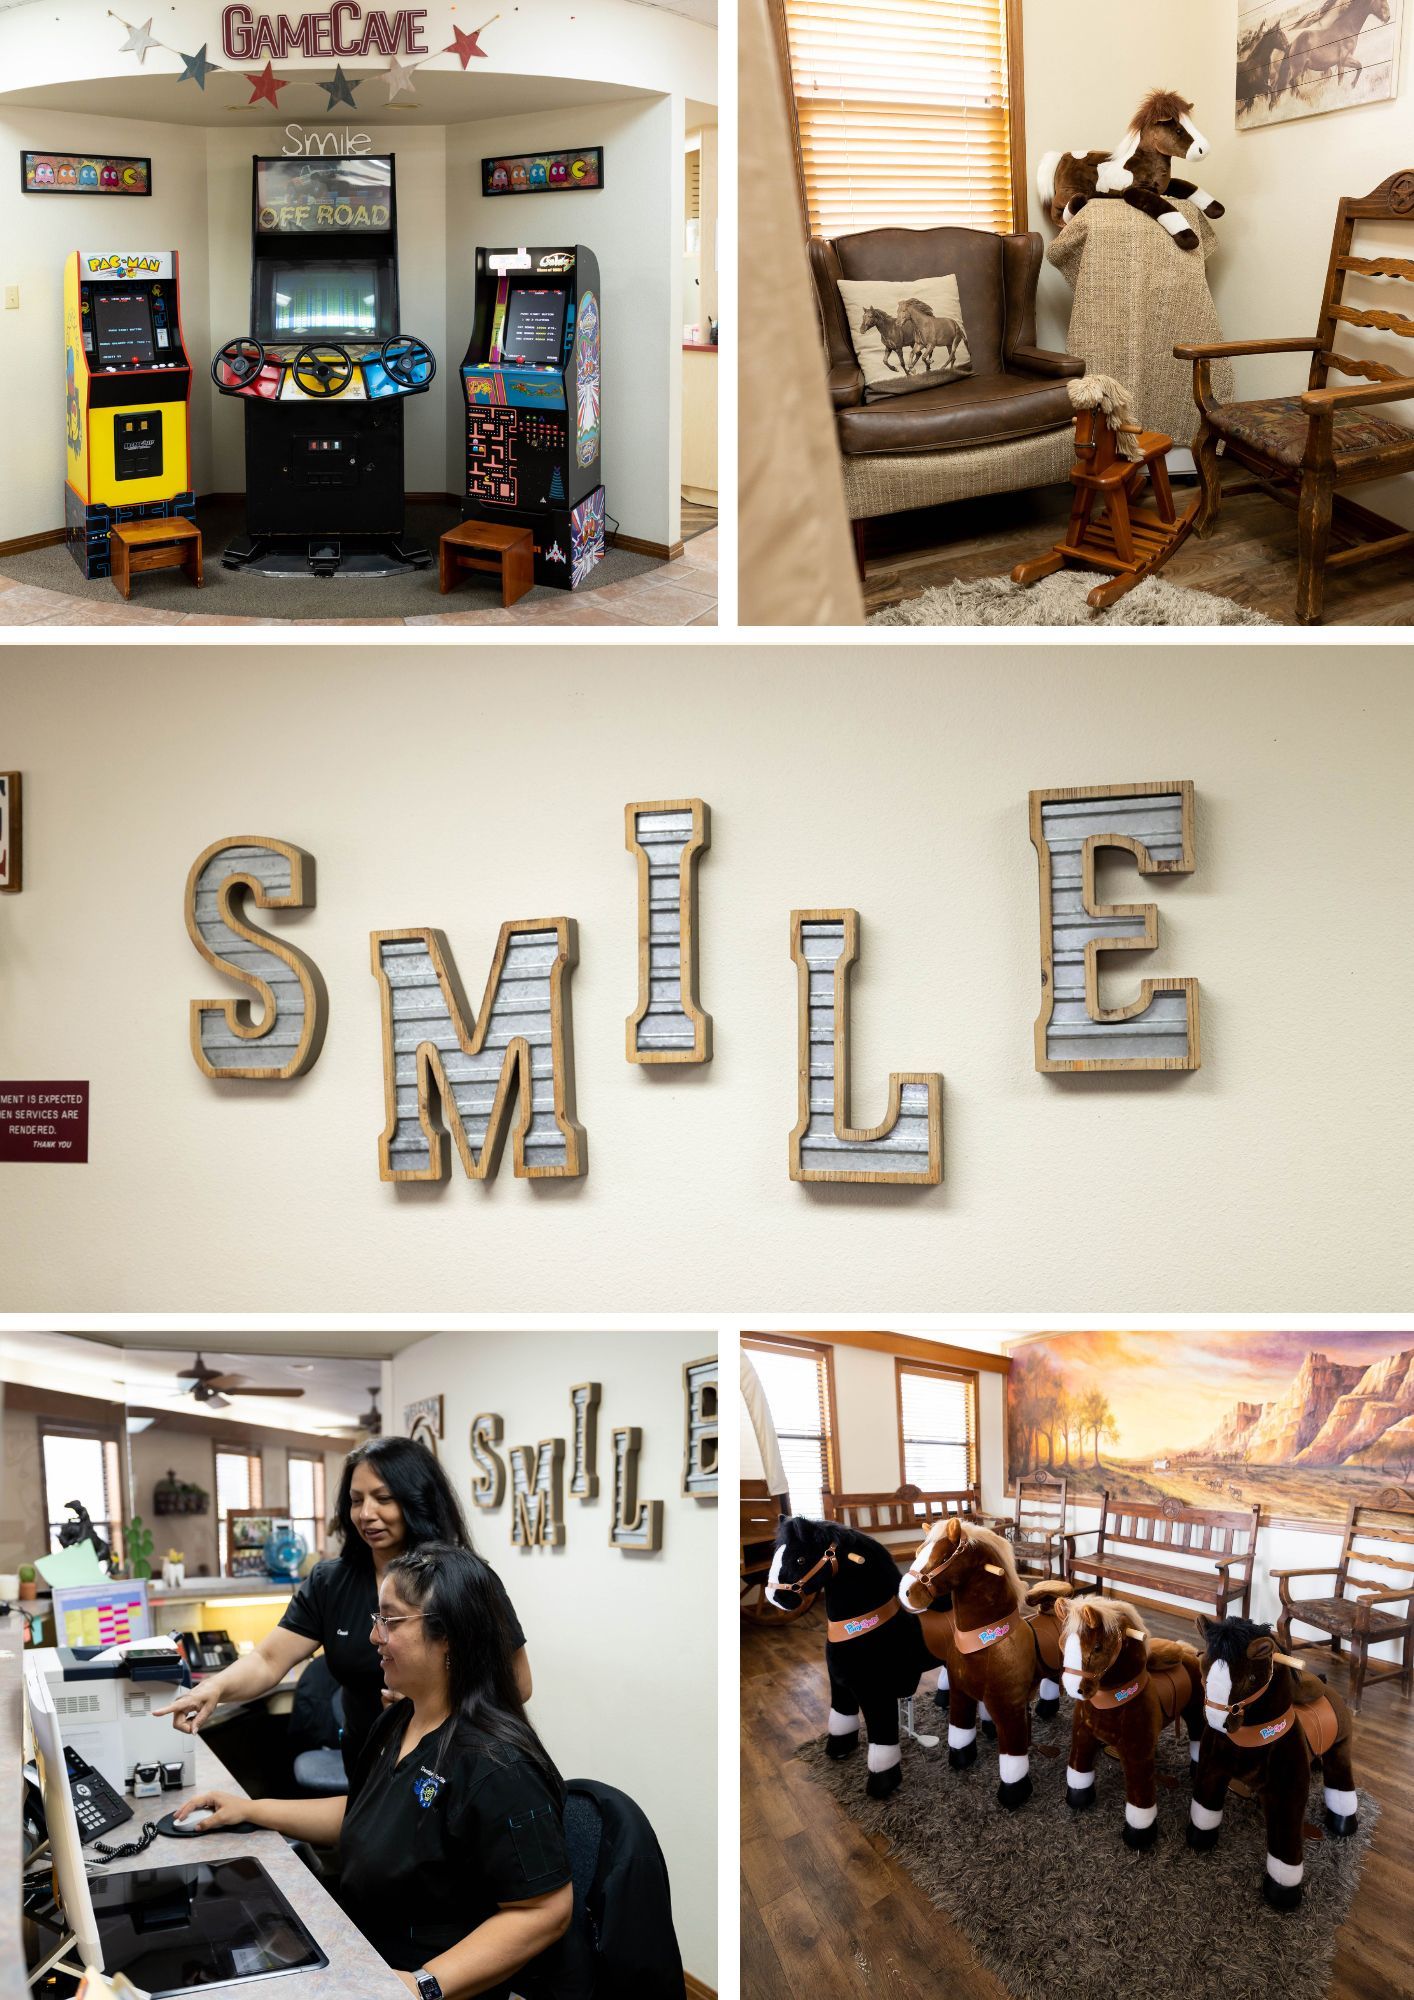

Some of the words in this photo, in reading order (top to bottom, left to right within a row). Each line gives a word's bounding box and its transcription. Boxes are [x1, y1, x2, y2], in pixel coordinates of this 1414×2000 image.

[281, 123, 372, 155] Smile
[259, 206, 311, 229] OFF
[316, 204, 389, 226] ROAD
[88, 255, 161, 272] PAC-MAN
[184, 780, 1201, 1186] SMILE
[27, 1095, 36, 1104] IS
[38, 1095, 83, 1104] EXPECTED
[15, 1110, 59, 1119] SERVICES
[61, 1110, 79, 1119] ARE
[9, 1125, 57, 1135] RENDERED.
[33, 1140, 56, 1149] THANK
[58, 1140, 72, 1149] YOU
